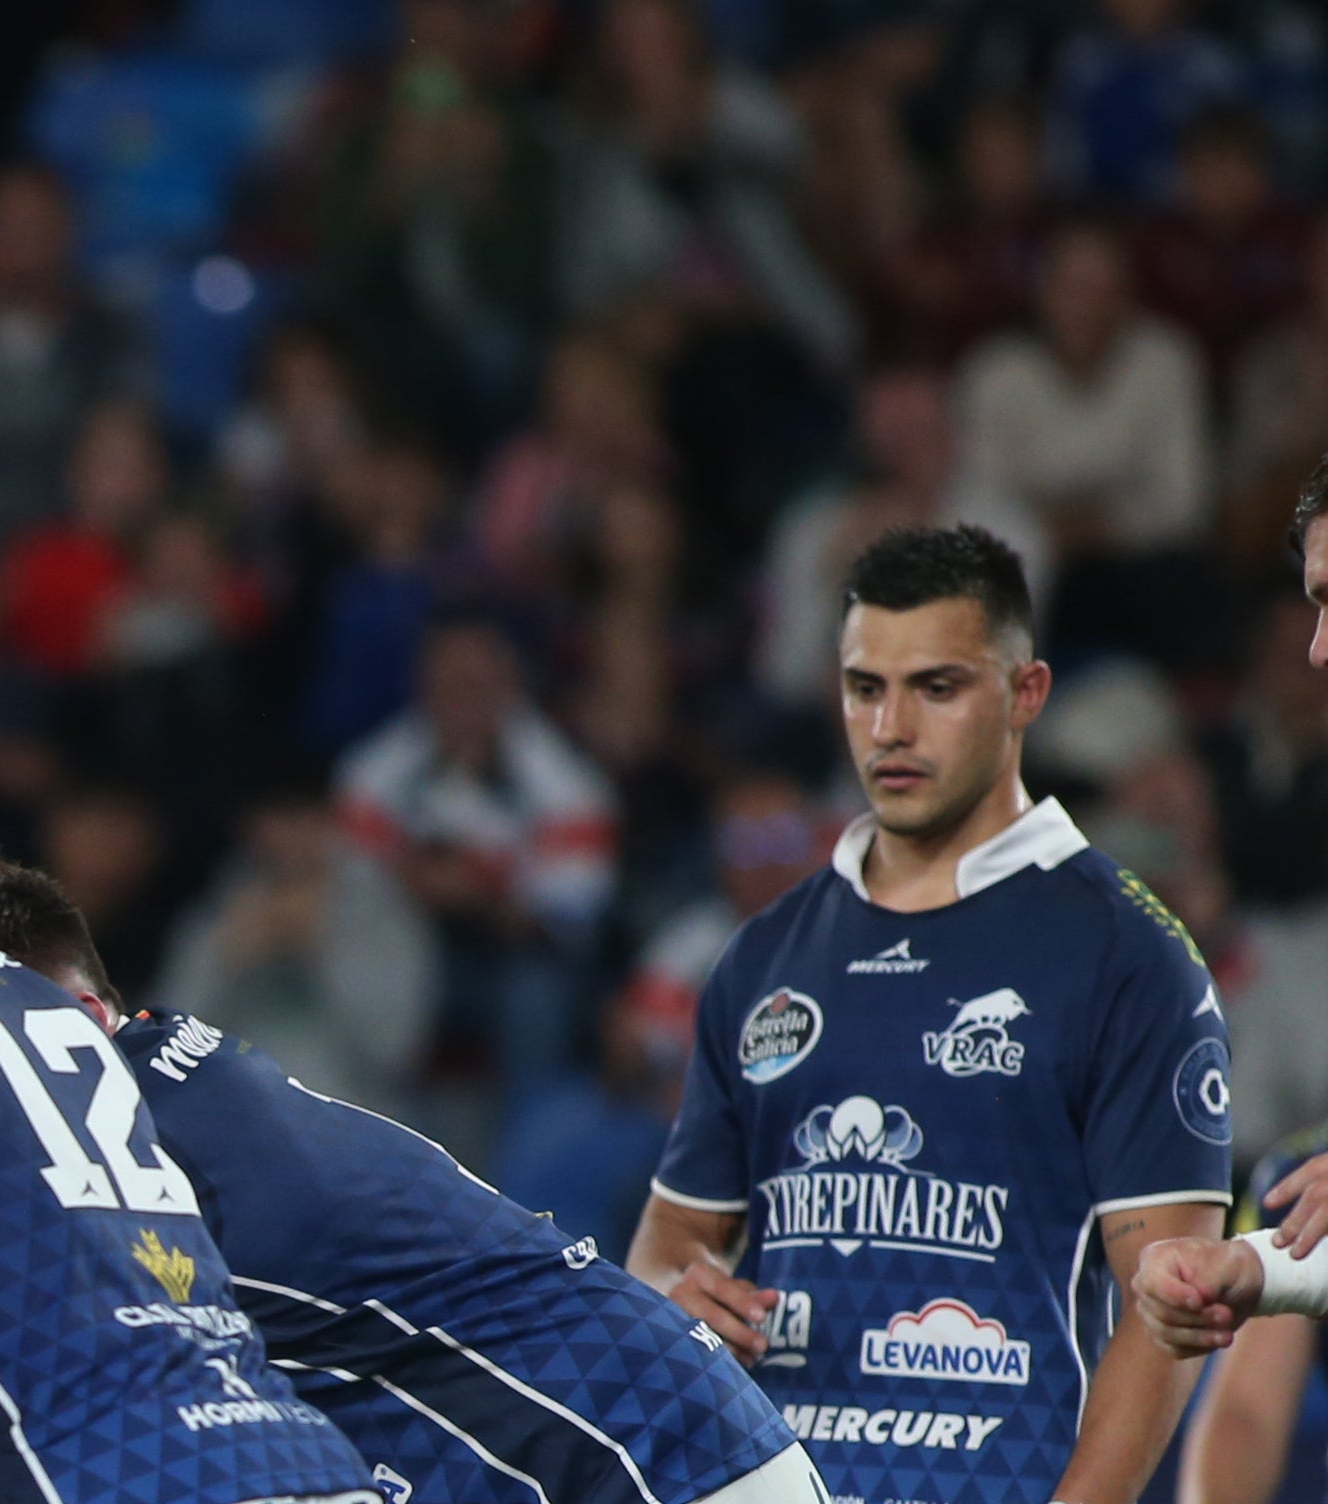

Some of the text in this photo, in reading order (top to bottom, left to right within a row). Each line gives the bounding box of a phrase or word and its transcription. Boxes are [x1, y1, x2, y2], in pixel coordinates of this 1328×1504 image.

[846, 958, 930, 975] MERCURY
[921, 1031, 1025, 1077] VRAC
[865, 1336, 1025, 1378] LEVANOVA
[783, 1403, 1004, 1451] MERCURY
